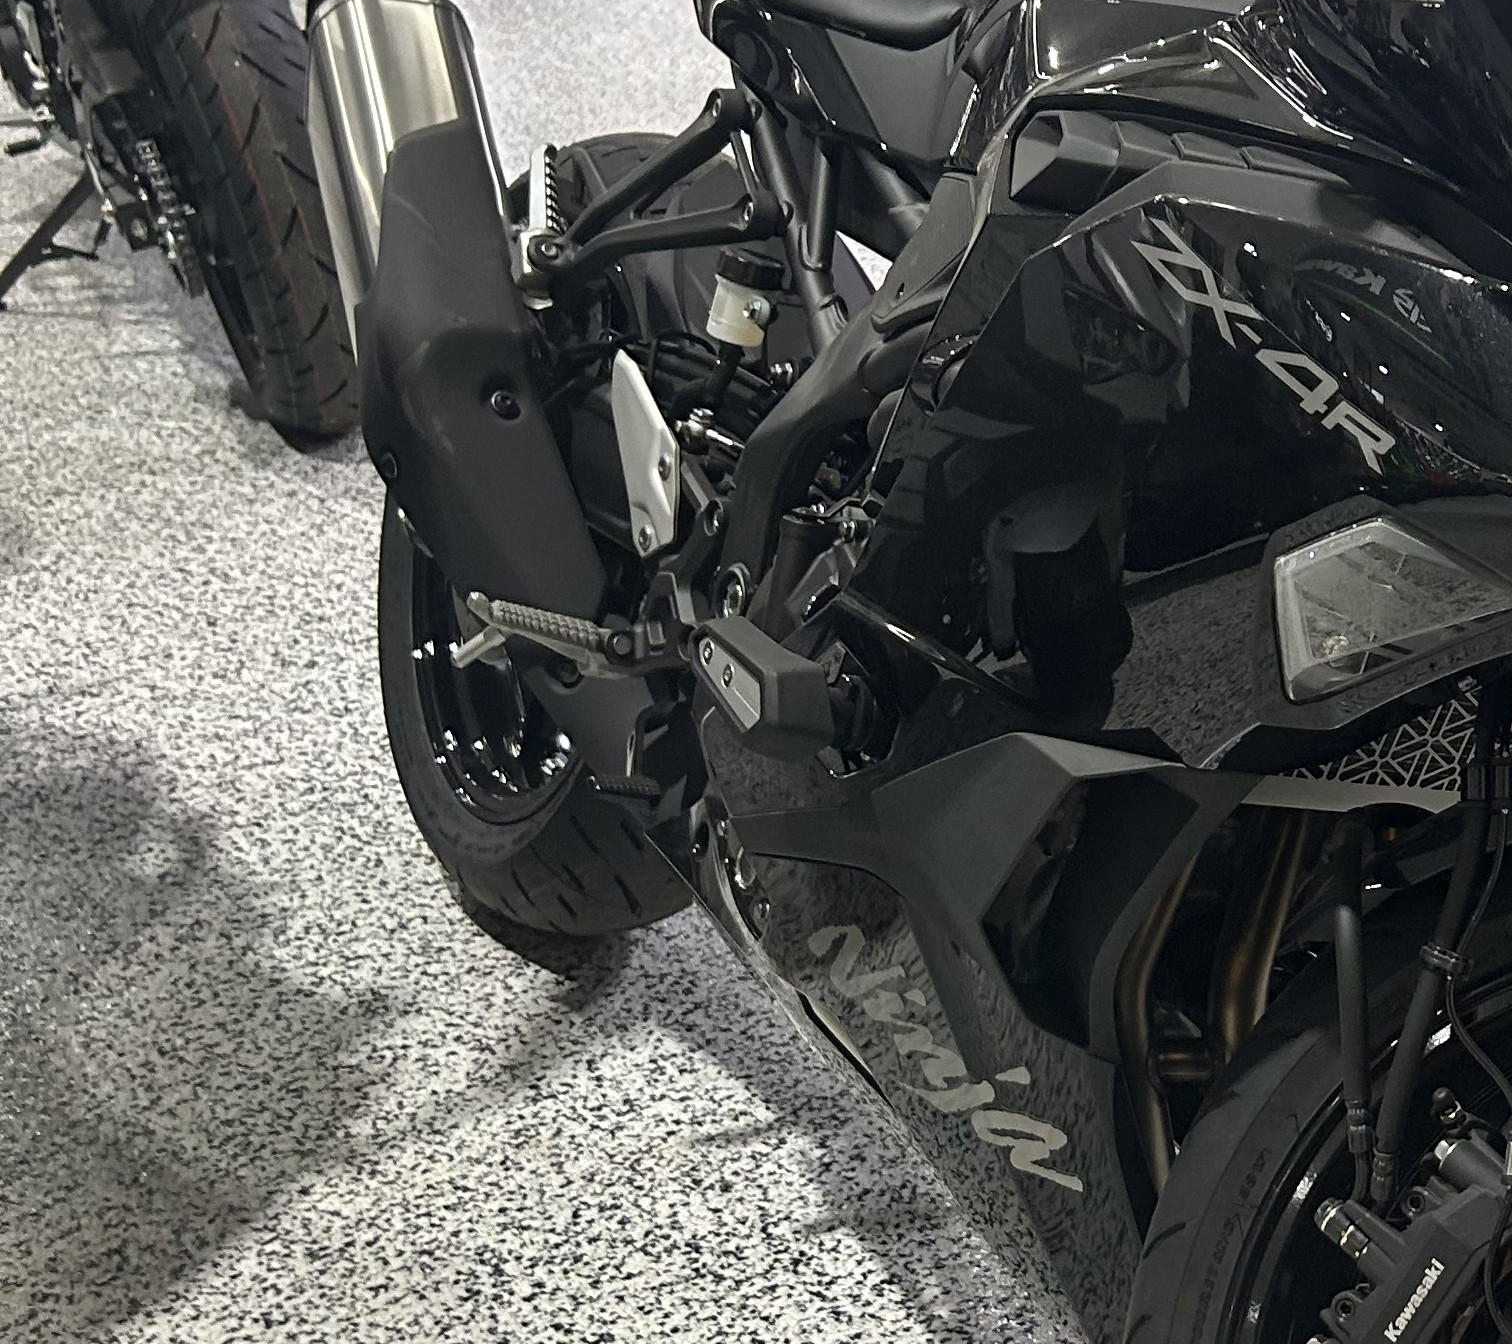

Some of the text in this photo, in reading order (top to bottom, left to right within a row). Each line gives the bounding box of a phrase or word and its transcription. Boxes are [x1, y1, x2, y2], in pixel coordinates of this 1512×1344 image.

[1130, 217, 1397, 476] ZX-4R
[808, 924, 1083, 1193] Ninja
[1384, 1258, 1445, 1343] Kawasaki
